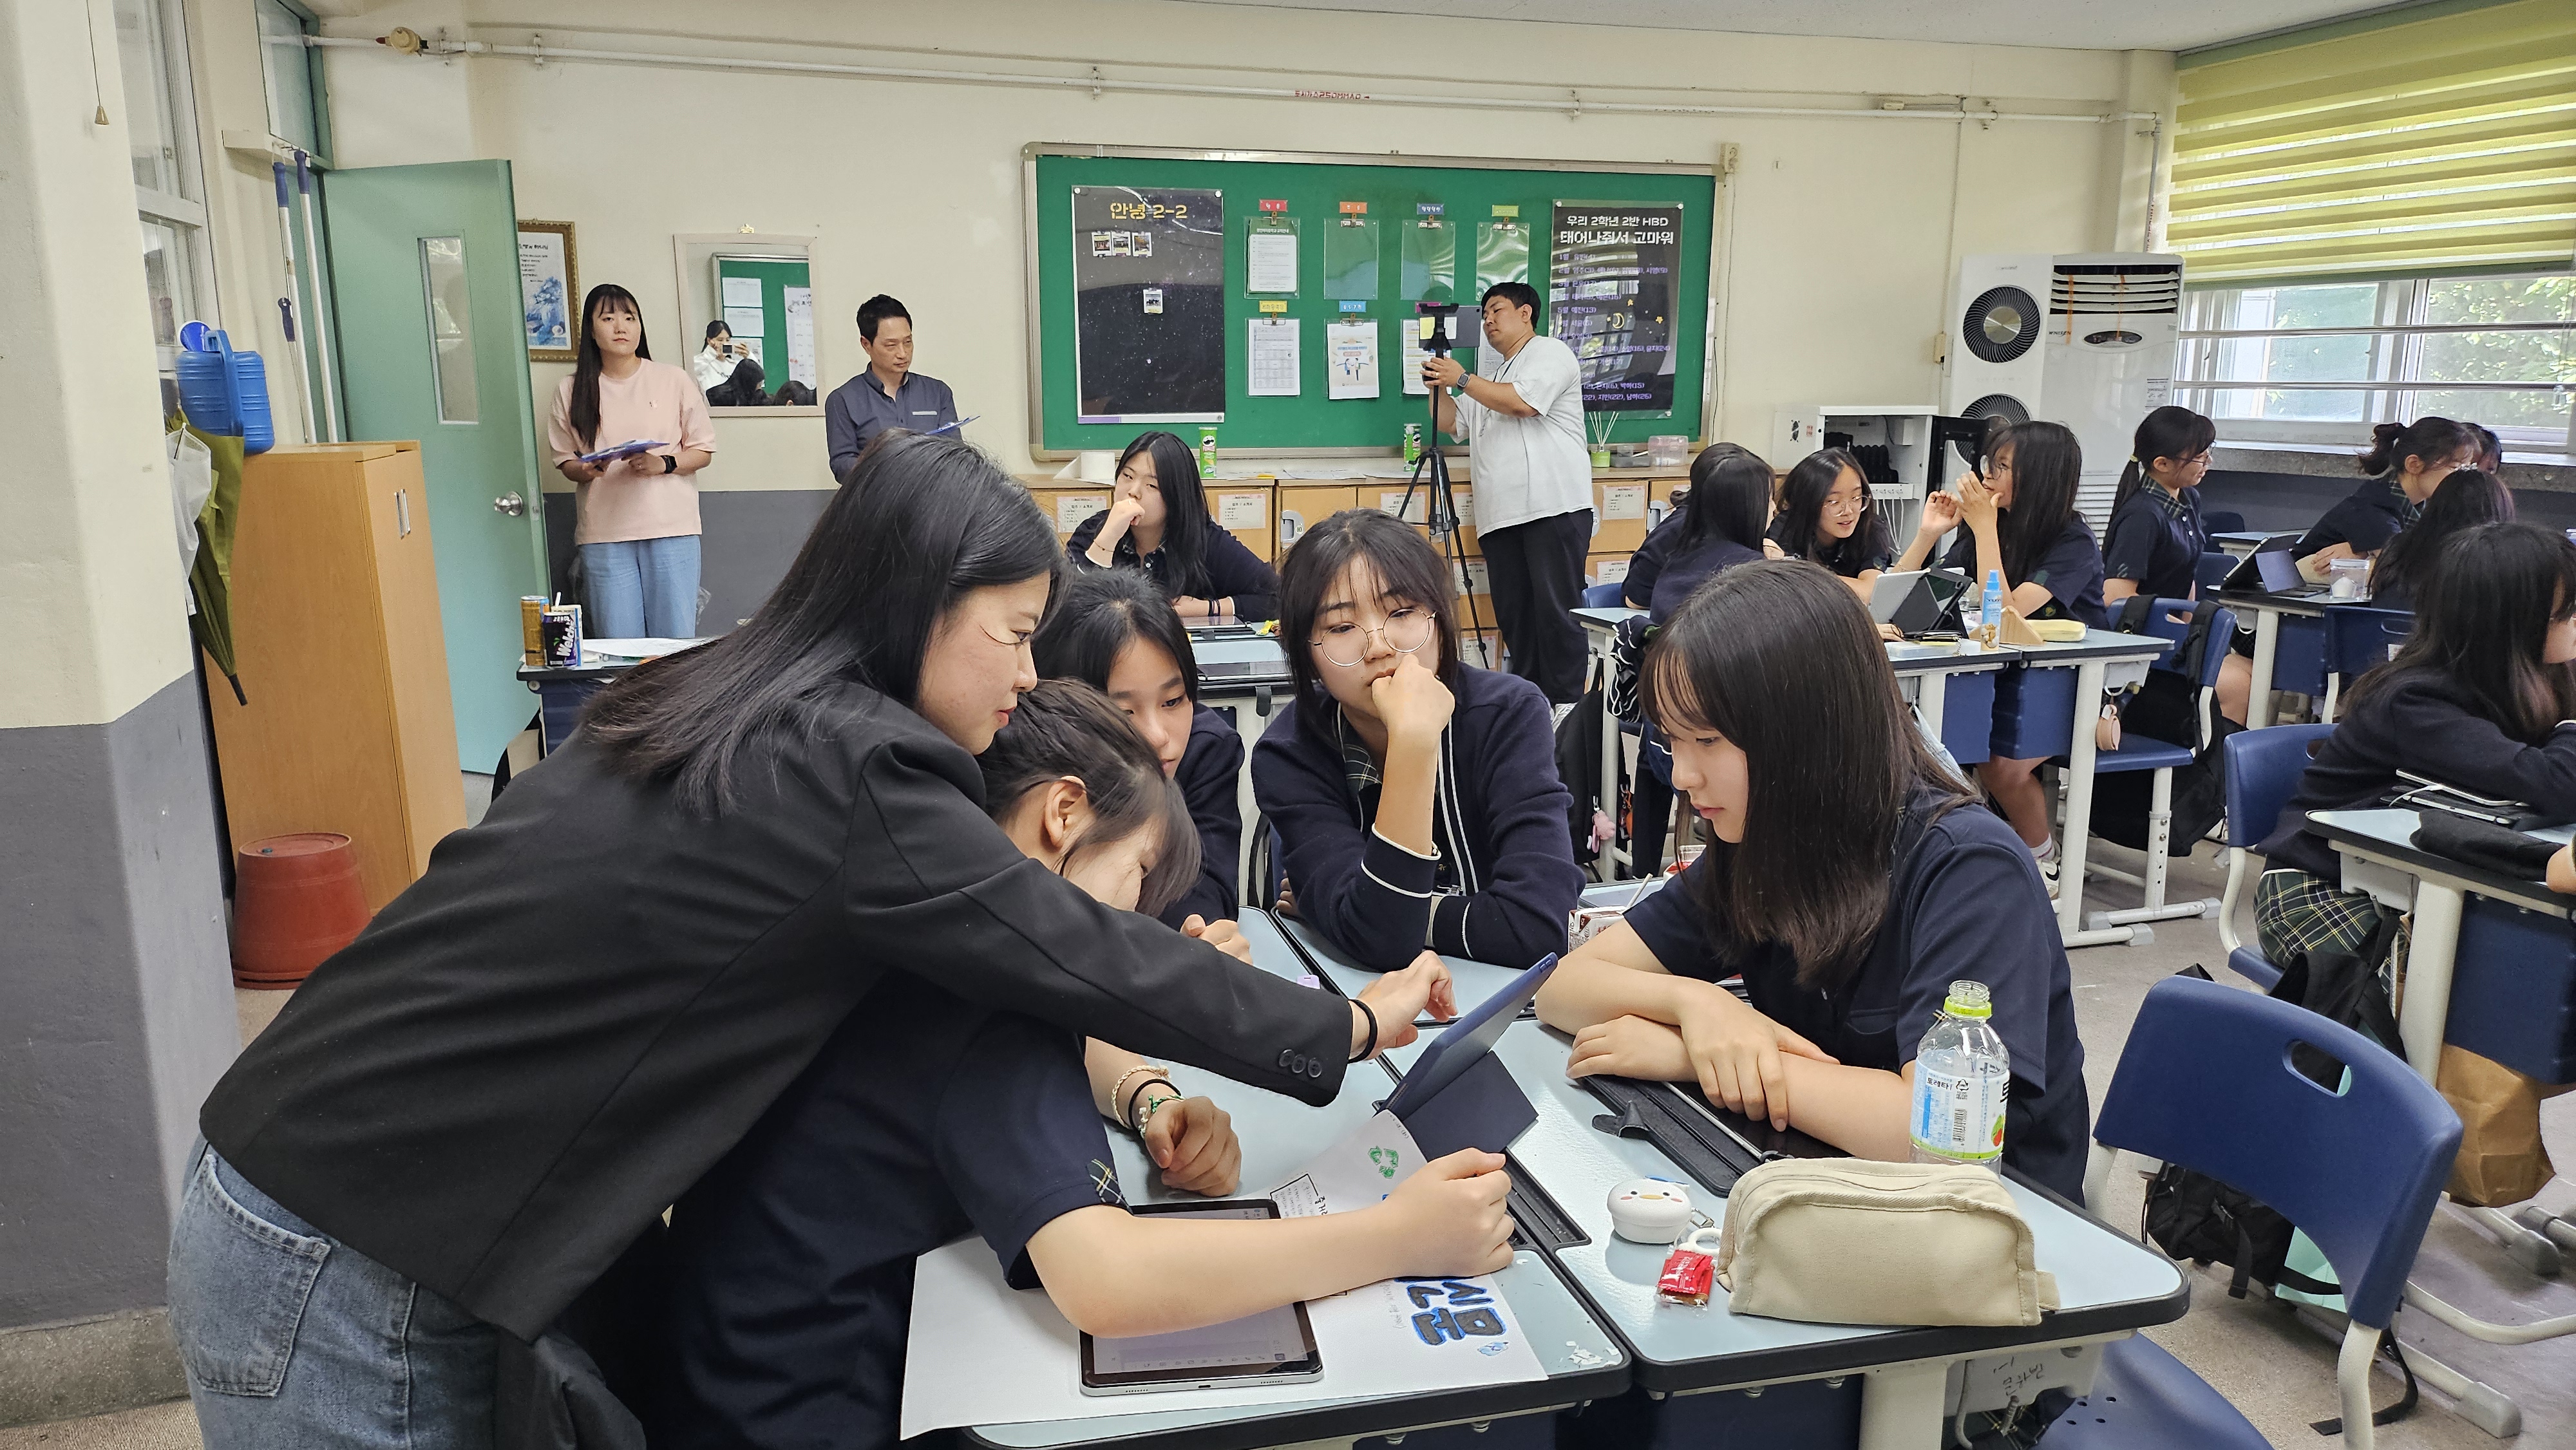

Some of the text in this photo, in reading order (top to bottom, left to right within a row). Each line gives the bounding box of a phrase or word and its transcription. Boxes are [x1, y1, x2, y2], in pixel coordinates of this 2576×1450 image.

[1110, 202, 1188, 220] 안녕 2-2
[1566, 215, 1669, 227] 우리 2학년 2반 HBD
[1633, 231, 1674, 245] 고마워
